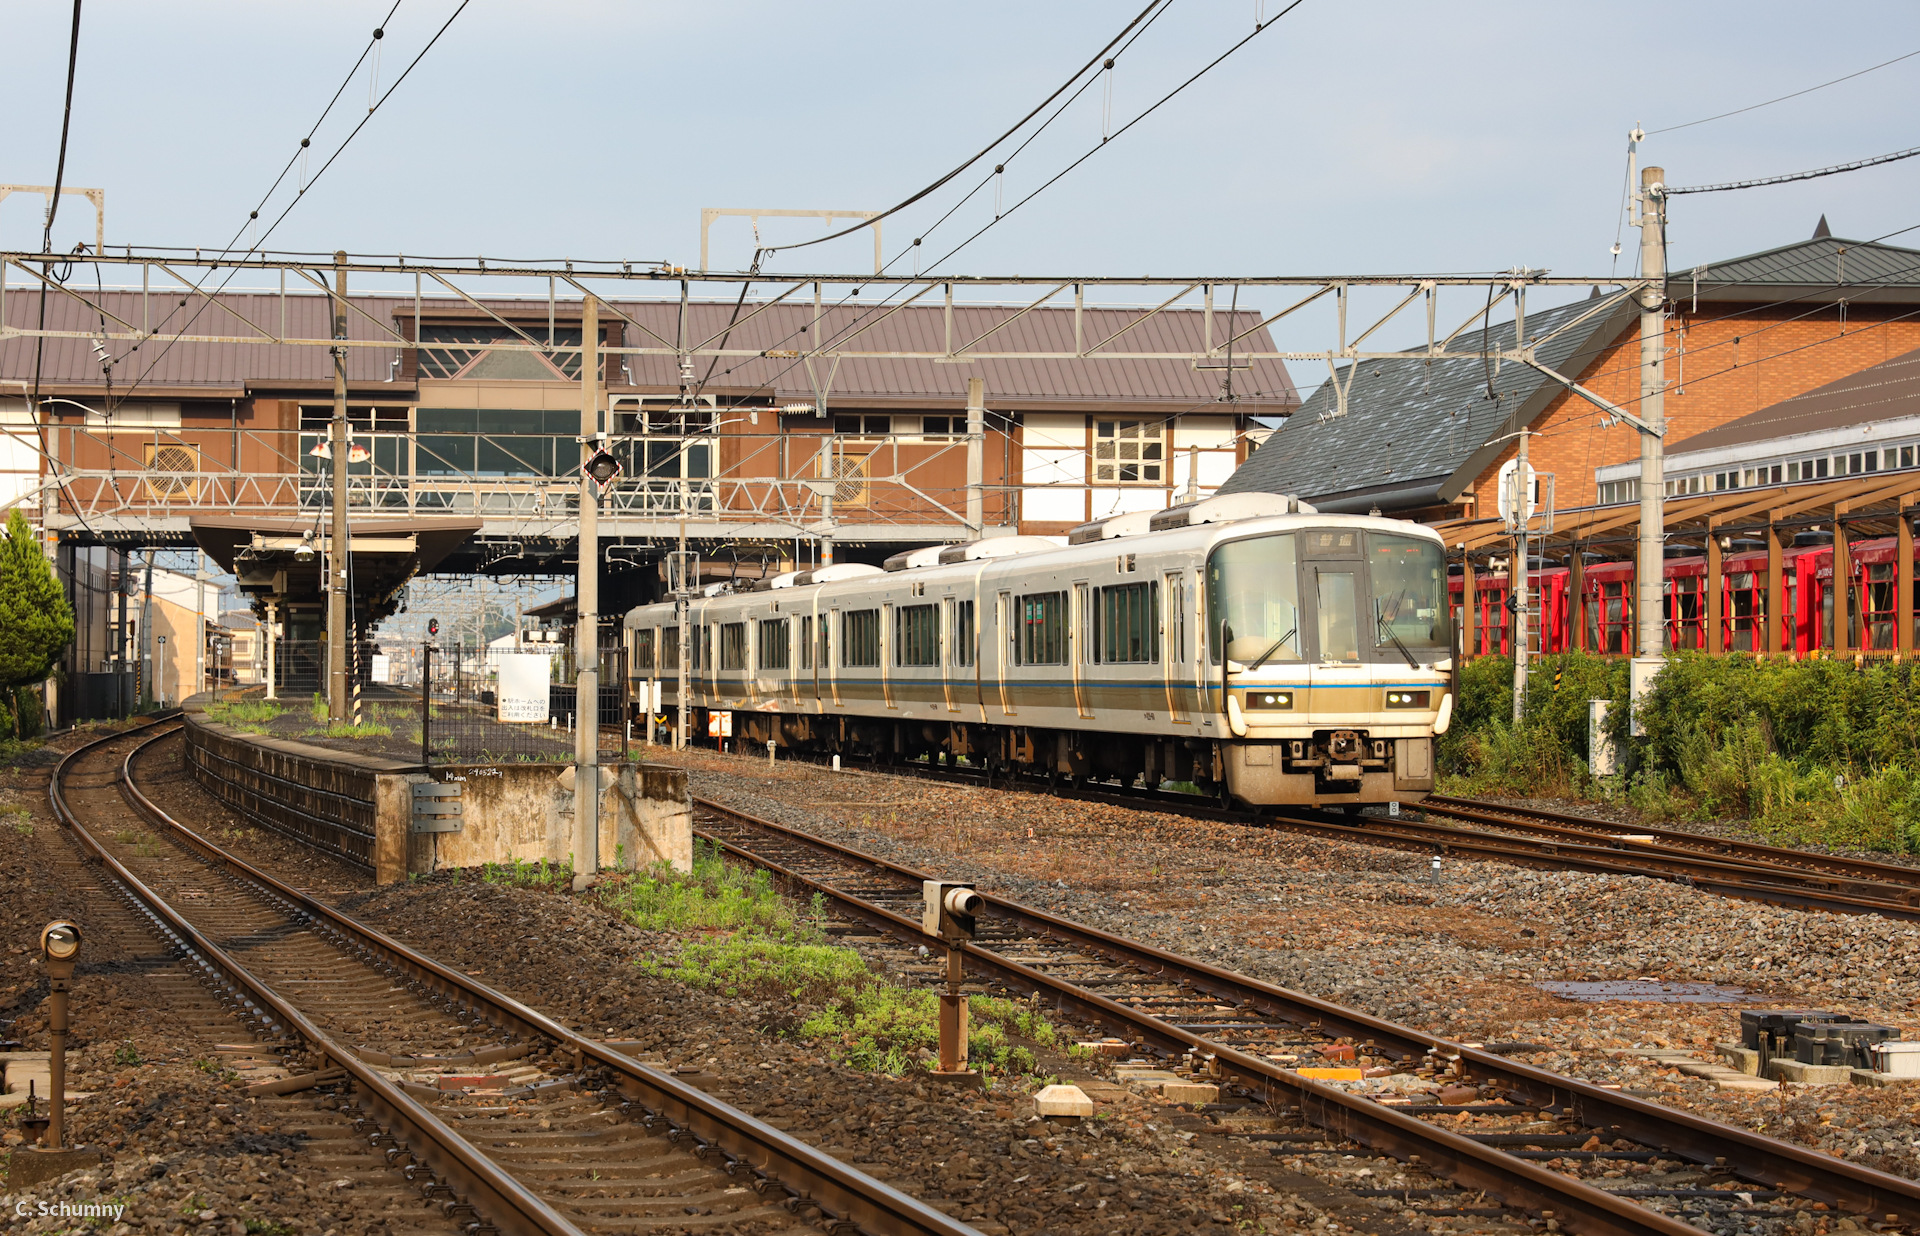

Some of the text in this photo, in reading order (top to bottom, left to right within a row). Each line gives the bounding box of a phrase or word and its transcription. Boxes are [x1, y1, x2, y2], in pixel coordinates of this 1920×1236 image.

[1319, 533, 1353, 547] 普通
[397, 588, 404, 599] 2
[501, 711, 546, 719] ご利用ください
